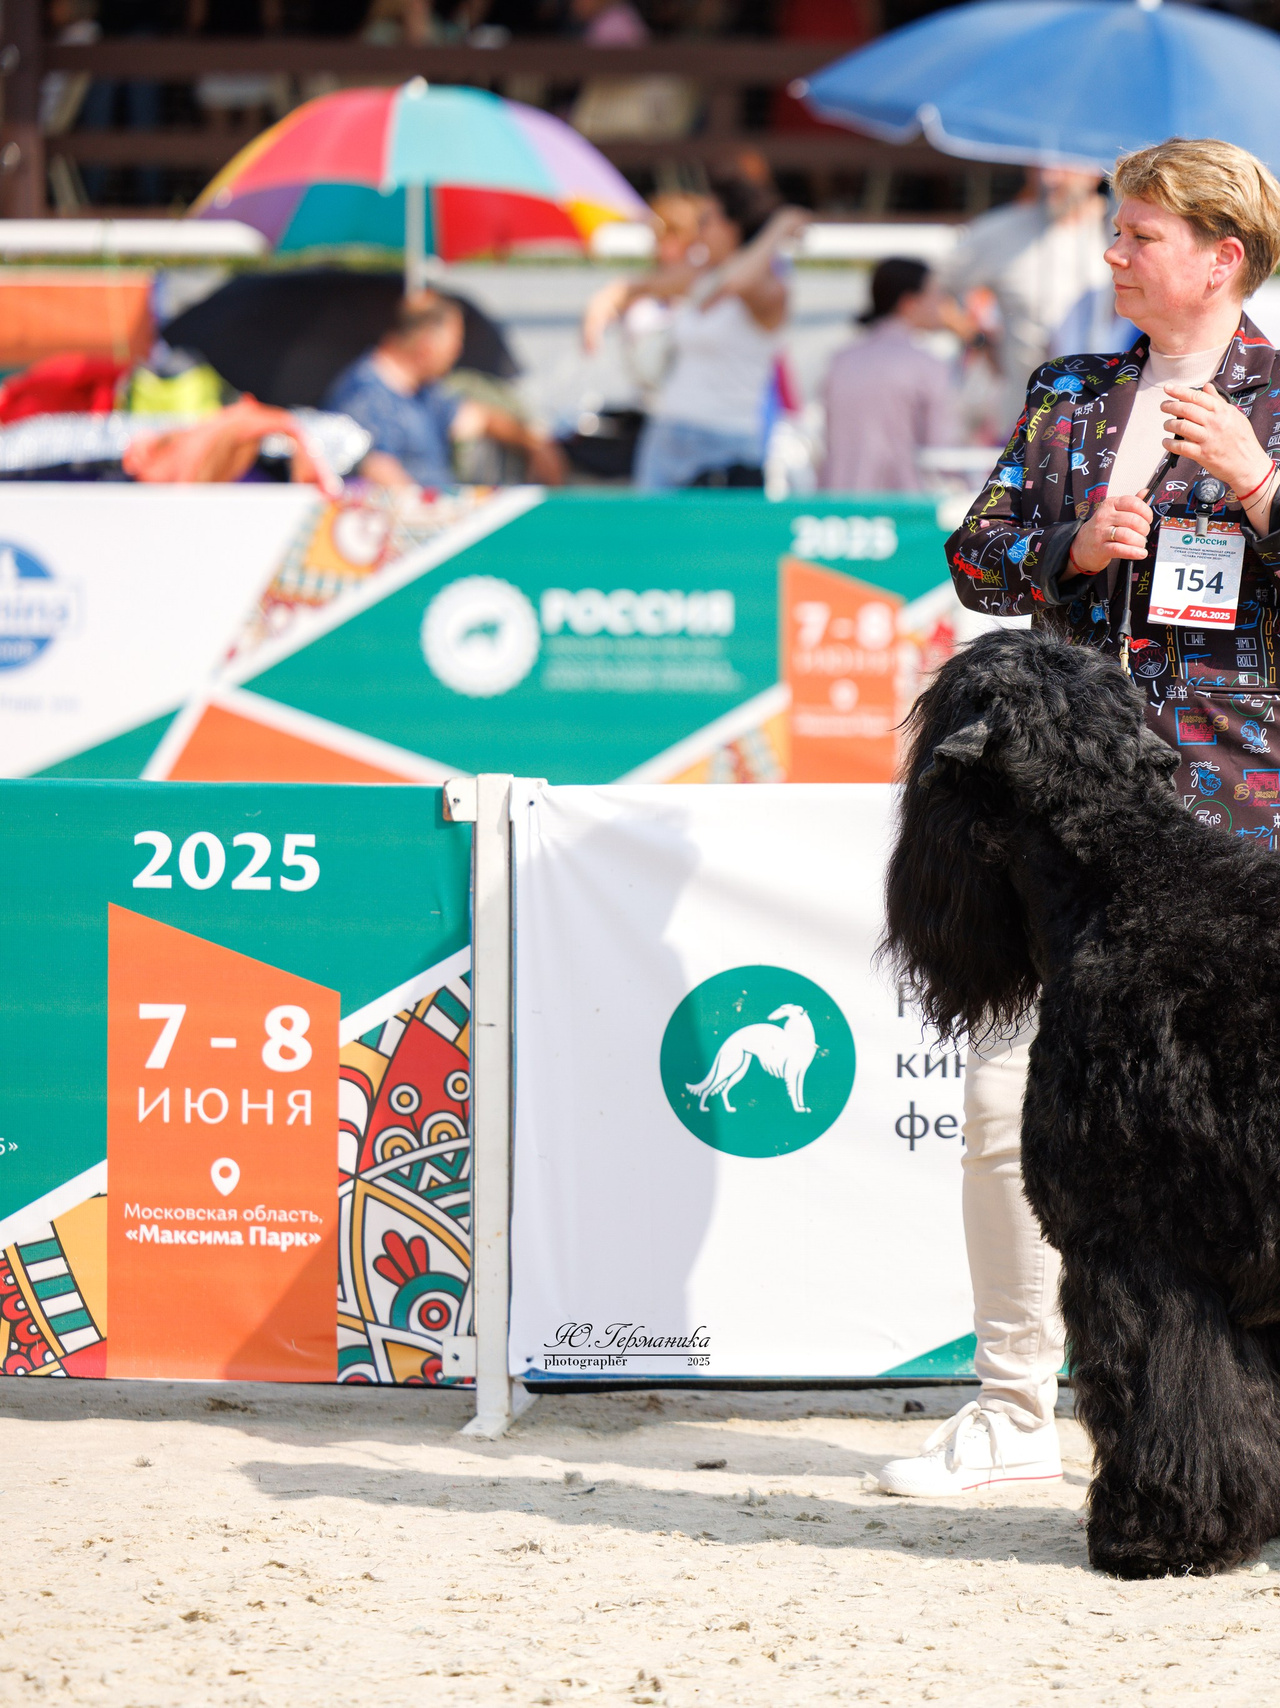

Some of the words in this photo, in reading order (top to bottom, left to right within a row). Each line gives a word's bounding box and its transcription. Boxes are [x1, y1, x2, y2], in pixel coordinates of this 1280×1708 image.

[1195, 537, 1228, 546] РОССИЯ
[1174, 568, 1224, 594] 154
[1189, 609, 1230, 620] 7.06.2025
[133, 831, 320, 892] 2025
[139, 1003, 187, 1070] 7
[261, 1004, 313, 1073] 8
[138, 1086, 312, 1126] ИЮНЯ
[895, 1101, 966, 1151] фе
[124, 1203, 238, 1220] Московская
[242, 1204, 323, 1225] область,
[125, 1224, 244, 1245] «Максима
[249, 1226, 322, 1253] Парк»
